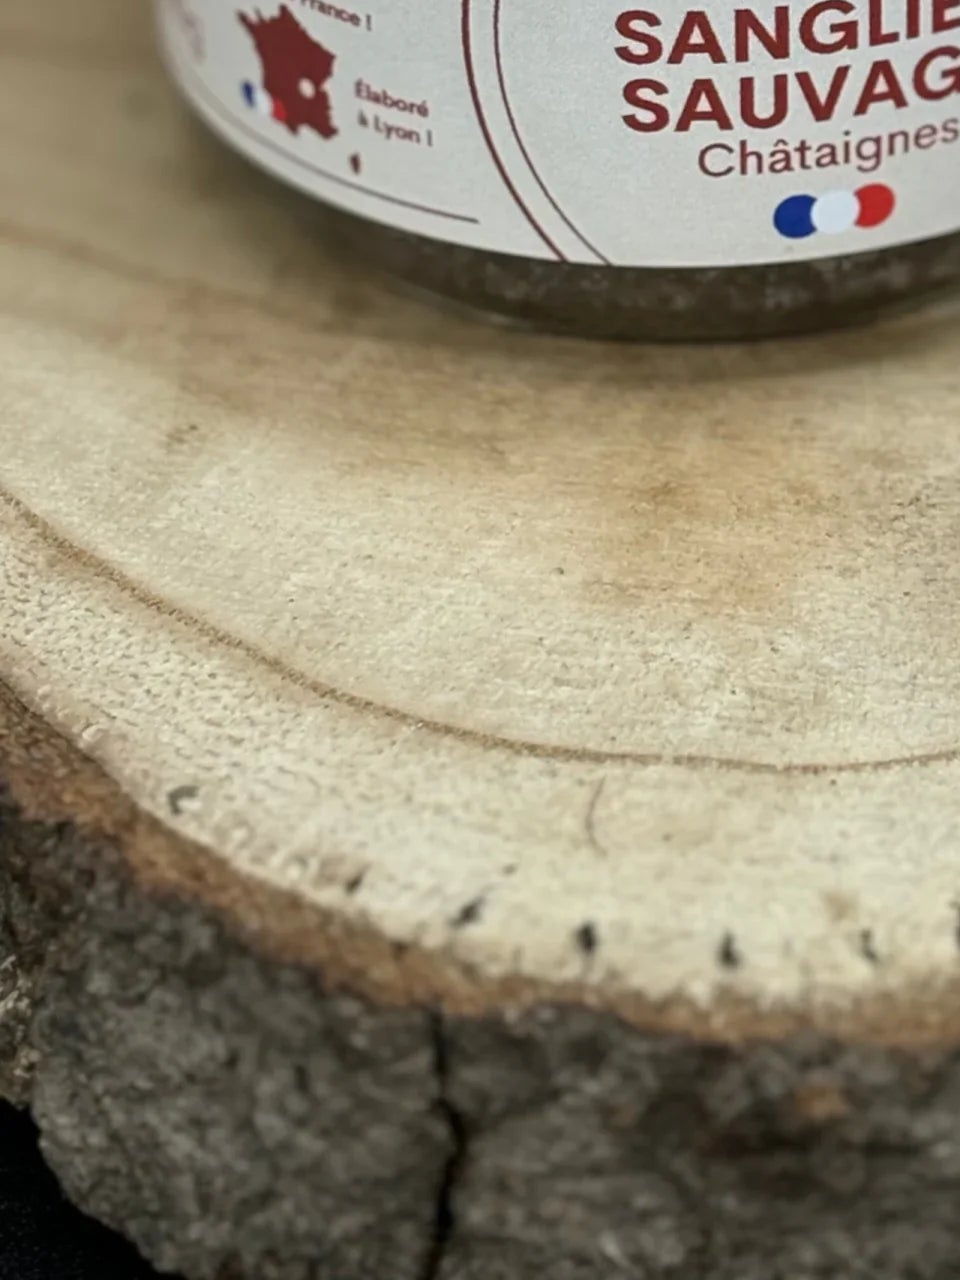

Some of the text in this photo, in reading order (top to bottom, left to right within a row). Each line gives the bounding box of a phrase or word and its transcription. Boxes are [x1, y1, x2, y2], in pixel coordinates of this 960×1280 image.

[354, 78, 429, 118] Élaboré
[373, 114, 421, 144] Lyon
[698, 118, 960, 178] Châtaignes
